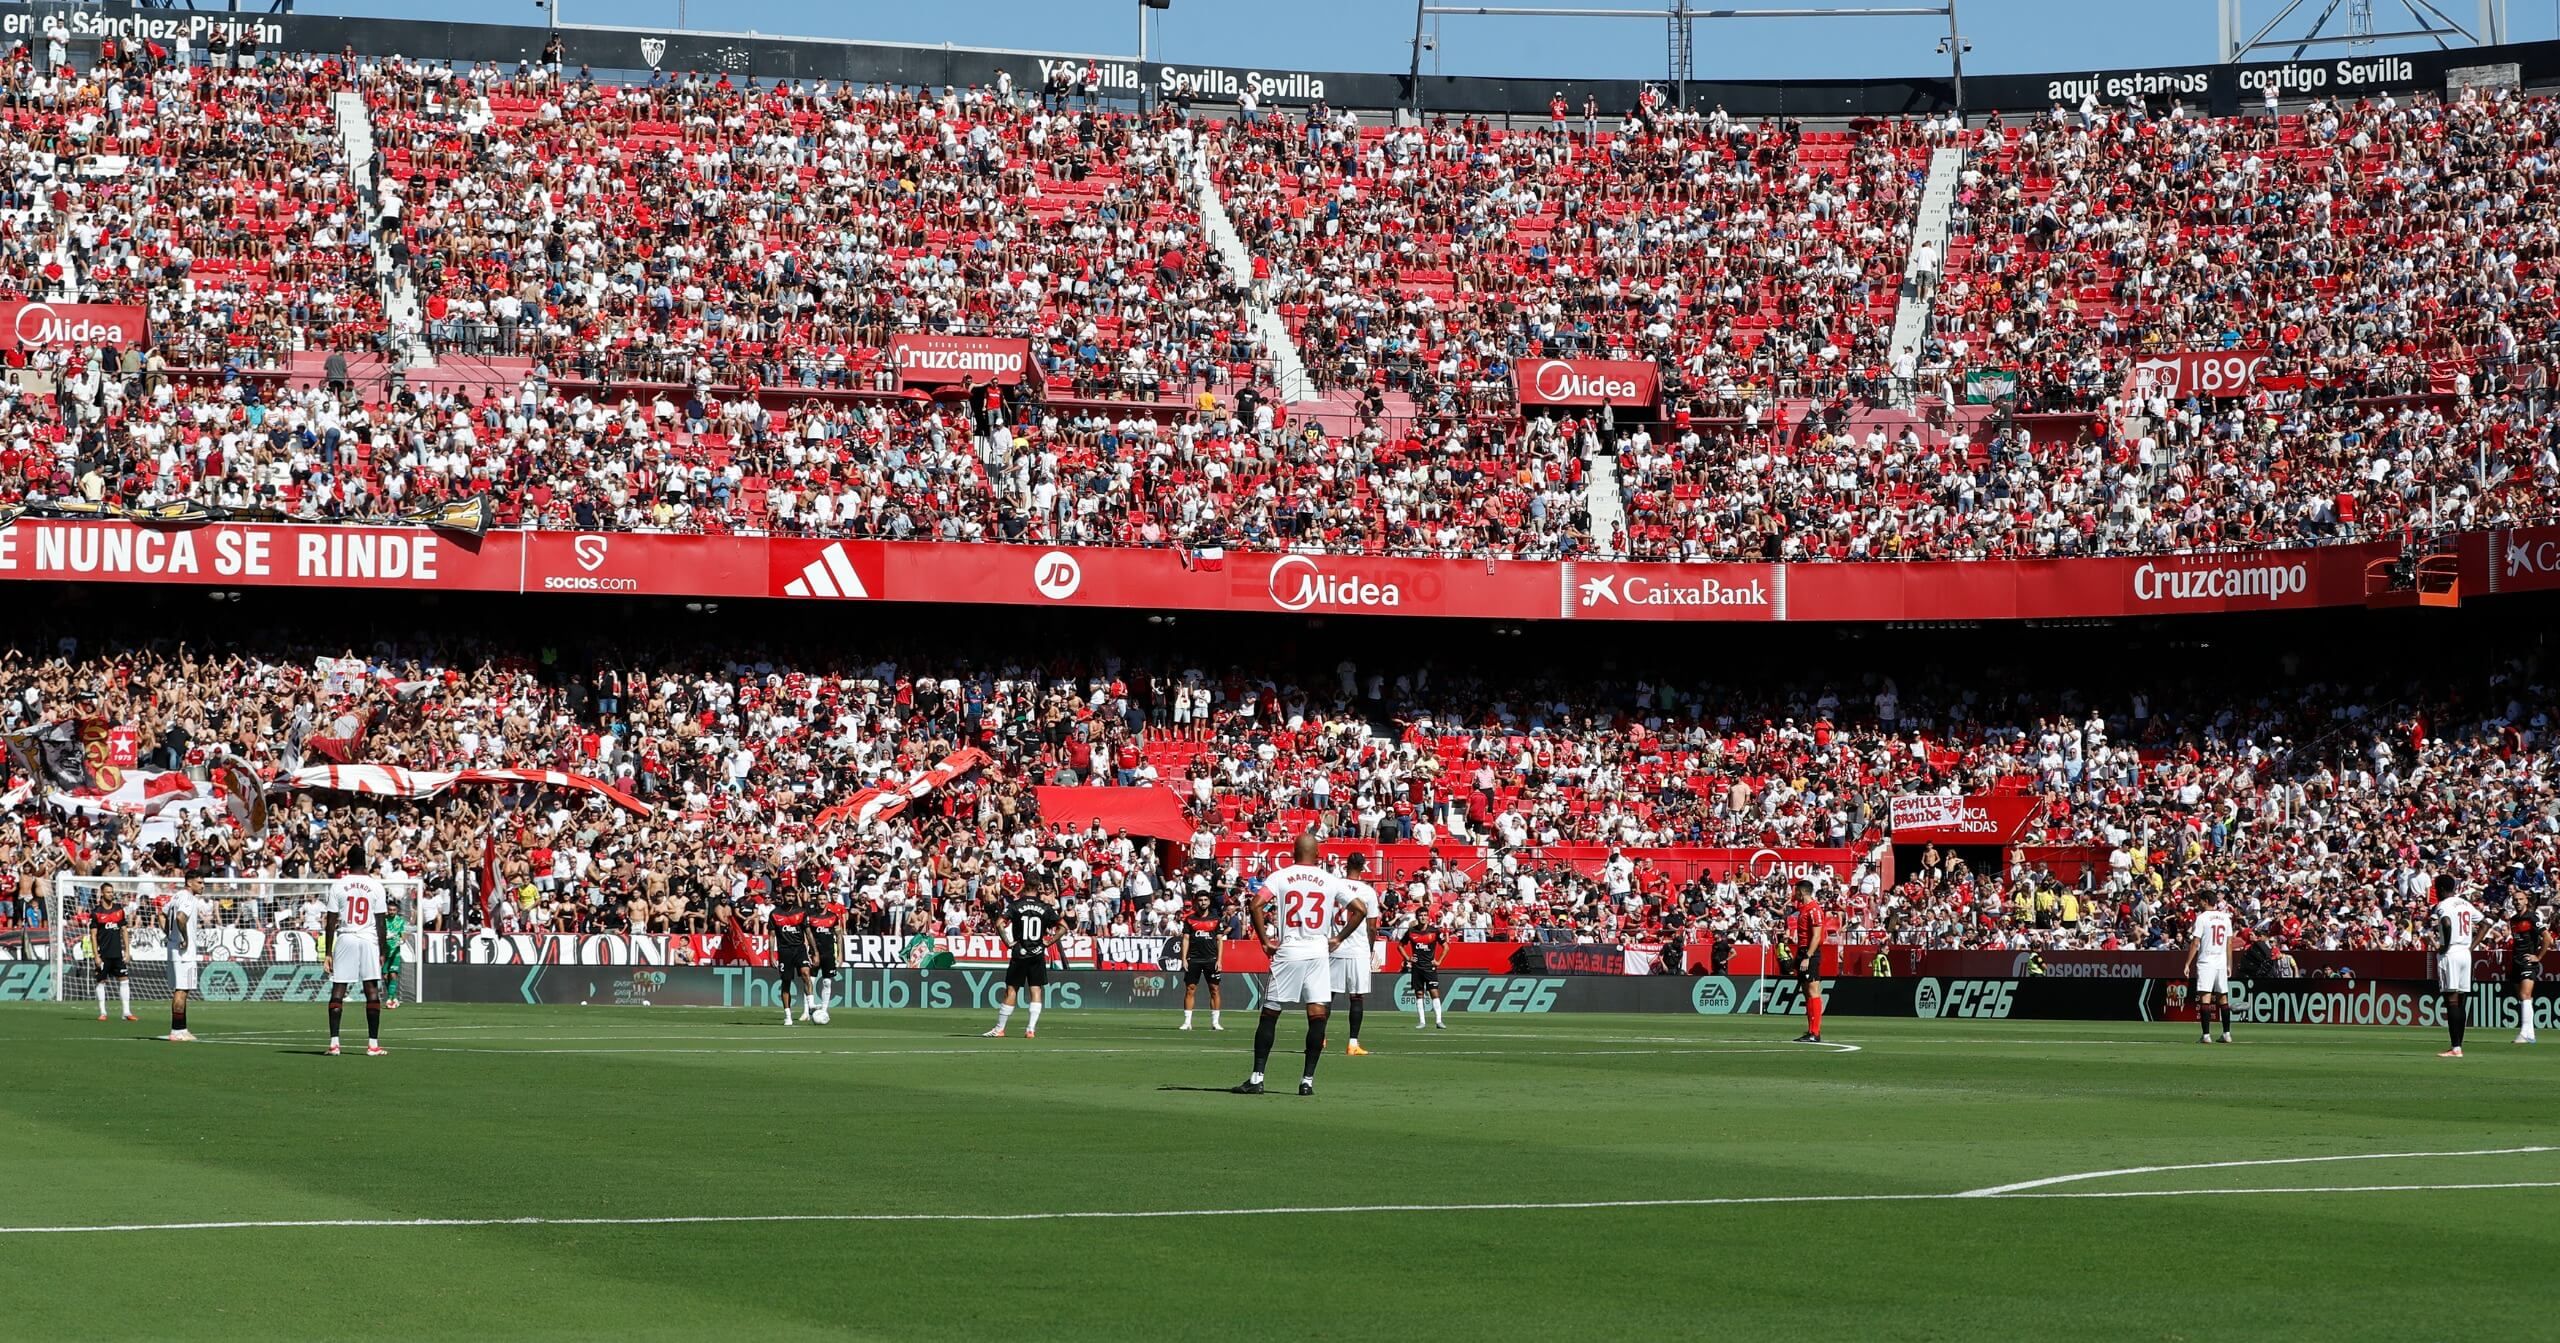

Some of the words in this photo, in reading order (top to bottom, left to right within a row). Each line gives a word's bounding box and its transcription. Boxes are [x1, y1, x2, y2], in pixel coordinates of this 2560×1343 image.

[4, 13, 32, 33] en
[42, 11, 64, 33] el
[73, 11, 178, 40] Sánchez
[191, 16, 282, 47] Pizjuán
[1037, 58, 1054, 83] Y
[1246, 71, 1325, 98] Sevilla
[2049, 73, 2099, 104] aquí
[2106, 70, 2208, 98] estamos
[2239, 66, 2327, 93] contigo
[2337, 57, 2413, 86] Sevilla
[895, 343, 1021, 375] Cruzcampo
[36, 526, 199, 575] NUNCA
[215, 530, 270, 576] SE
[299, 532, 438, 580] RINDE
[545, 576, 637, 590] SOCIOS.com
[1041, 563, 1074, 587] JD
[2134, 561, 2307, 601] Cruzcampo
[1622, 577, 1768, 606] CaixaBank
[1963, 807, 1988, 820] NCA
[346, 895, 369, 925] 19
[1284, 890, 1326, 929] 23
[2457, 911, 2471, 937] 18
[1020, 915, 1042, 941] 10
[2210, 924, 2226, 946] 16
[713, 966, 797, 1008] The
[812, 967, 910, 1009] Club
[921, 969, 952, 1009] is
[1442, 977, 1567, 1013] FC26
[1701, 983, 1728, 998] EA
[1919, 985, 1937, 1002] EA
[1941, 980, 2020, 1018] FC26
[1699, 999, 1730, 1007] SPORTS
[1918, 1002, 1938, 1010] SPORTS
[2226, 980, 2412, 1027] Bienvenidos
